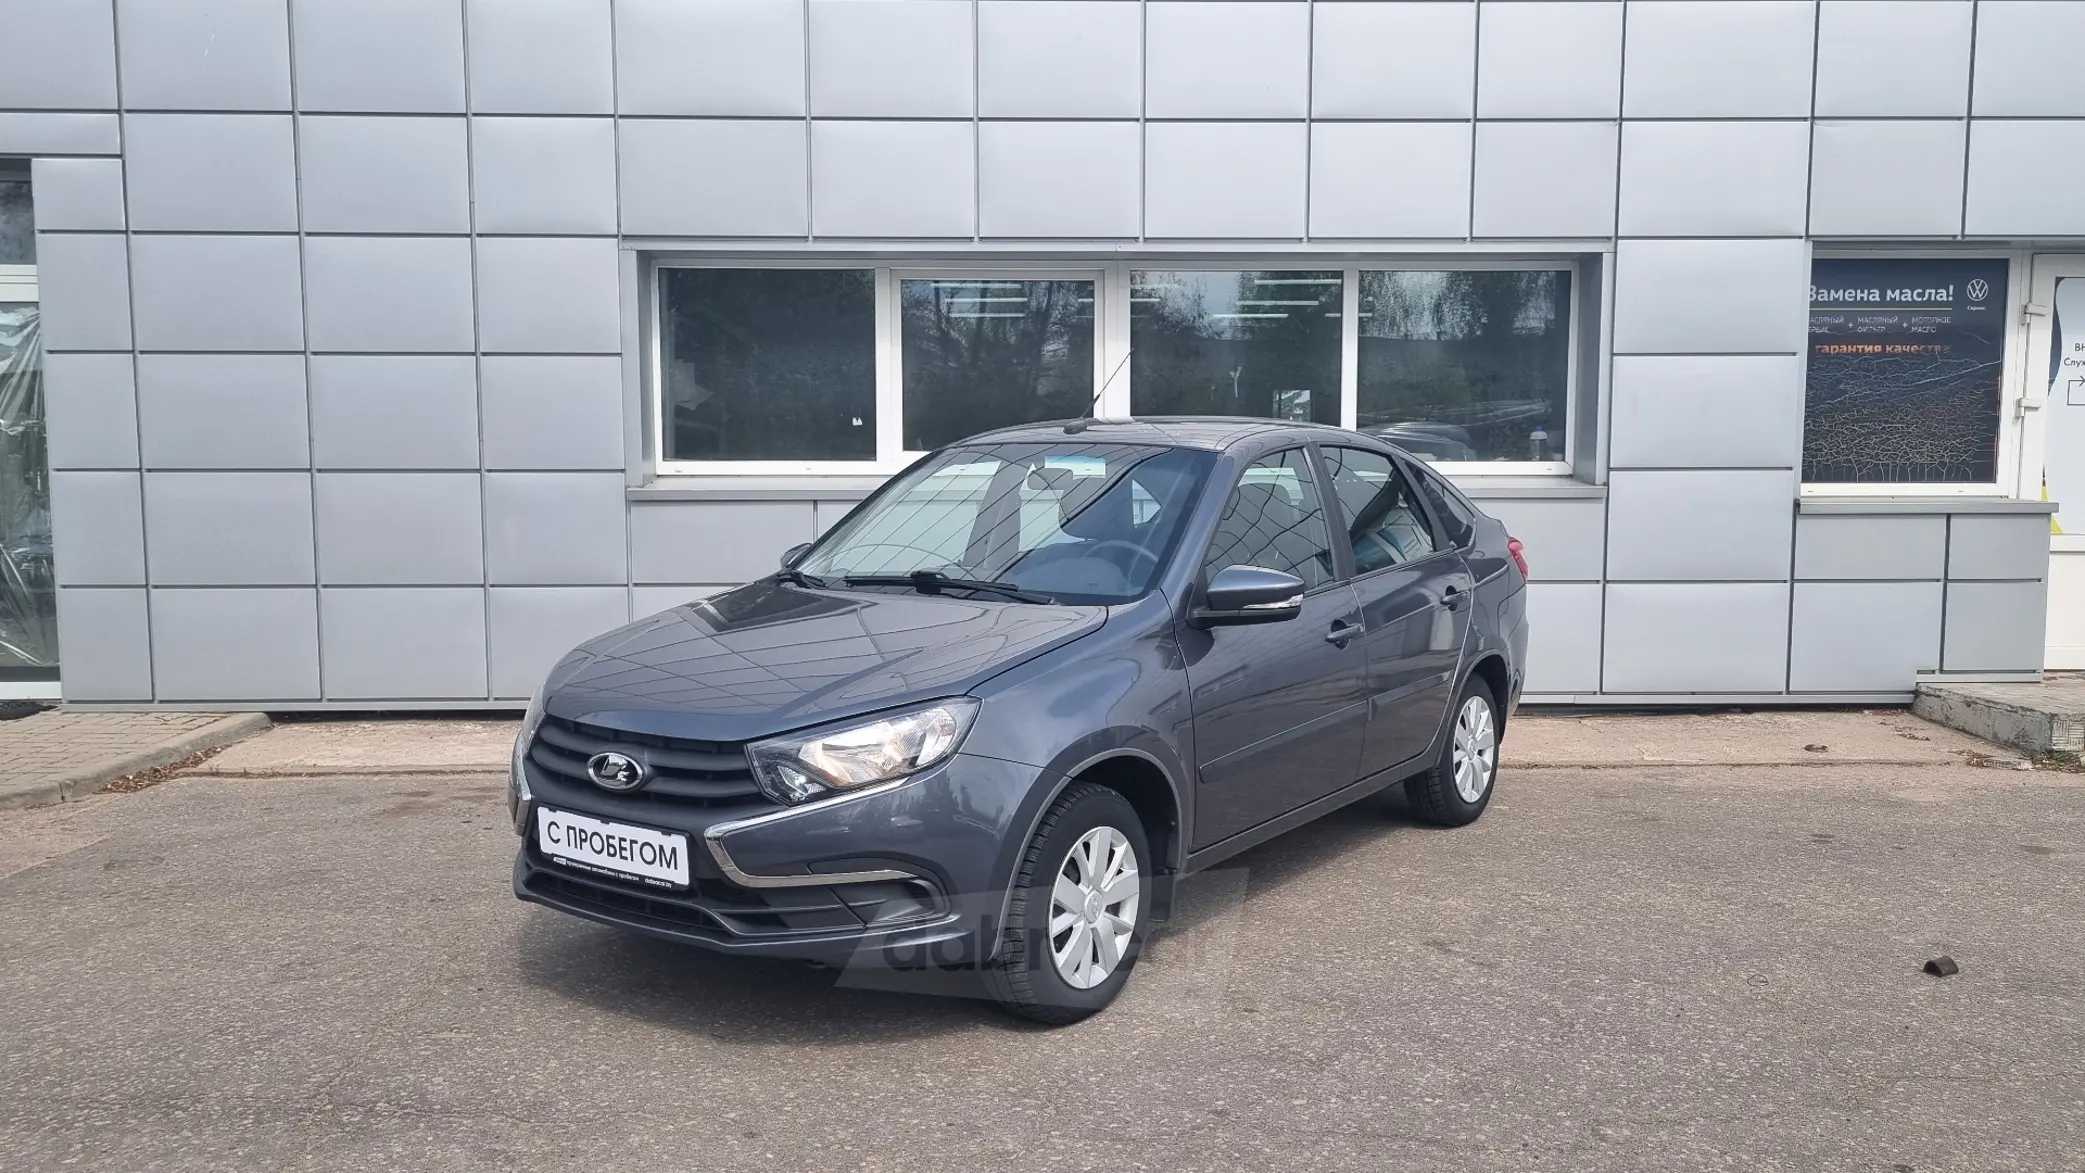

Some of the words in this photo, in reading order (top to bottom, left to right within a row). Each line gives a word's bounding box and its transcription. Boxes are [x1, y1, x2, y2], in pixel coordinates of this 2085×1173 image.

[1809, 285, 1881, 301] Замена
[1886, 285, 1954, 301] масла!
[1809, 316, 1844, 324] АСЛЯНЫЙ
[1815, 344, 1882, 354] гарантия
[547, 821, 561, 844] С
[566, 824, 678, 870] ПРОБЕГОМ
